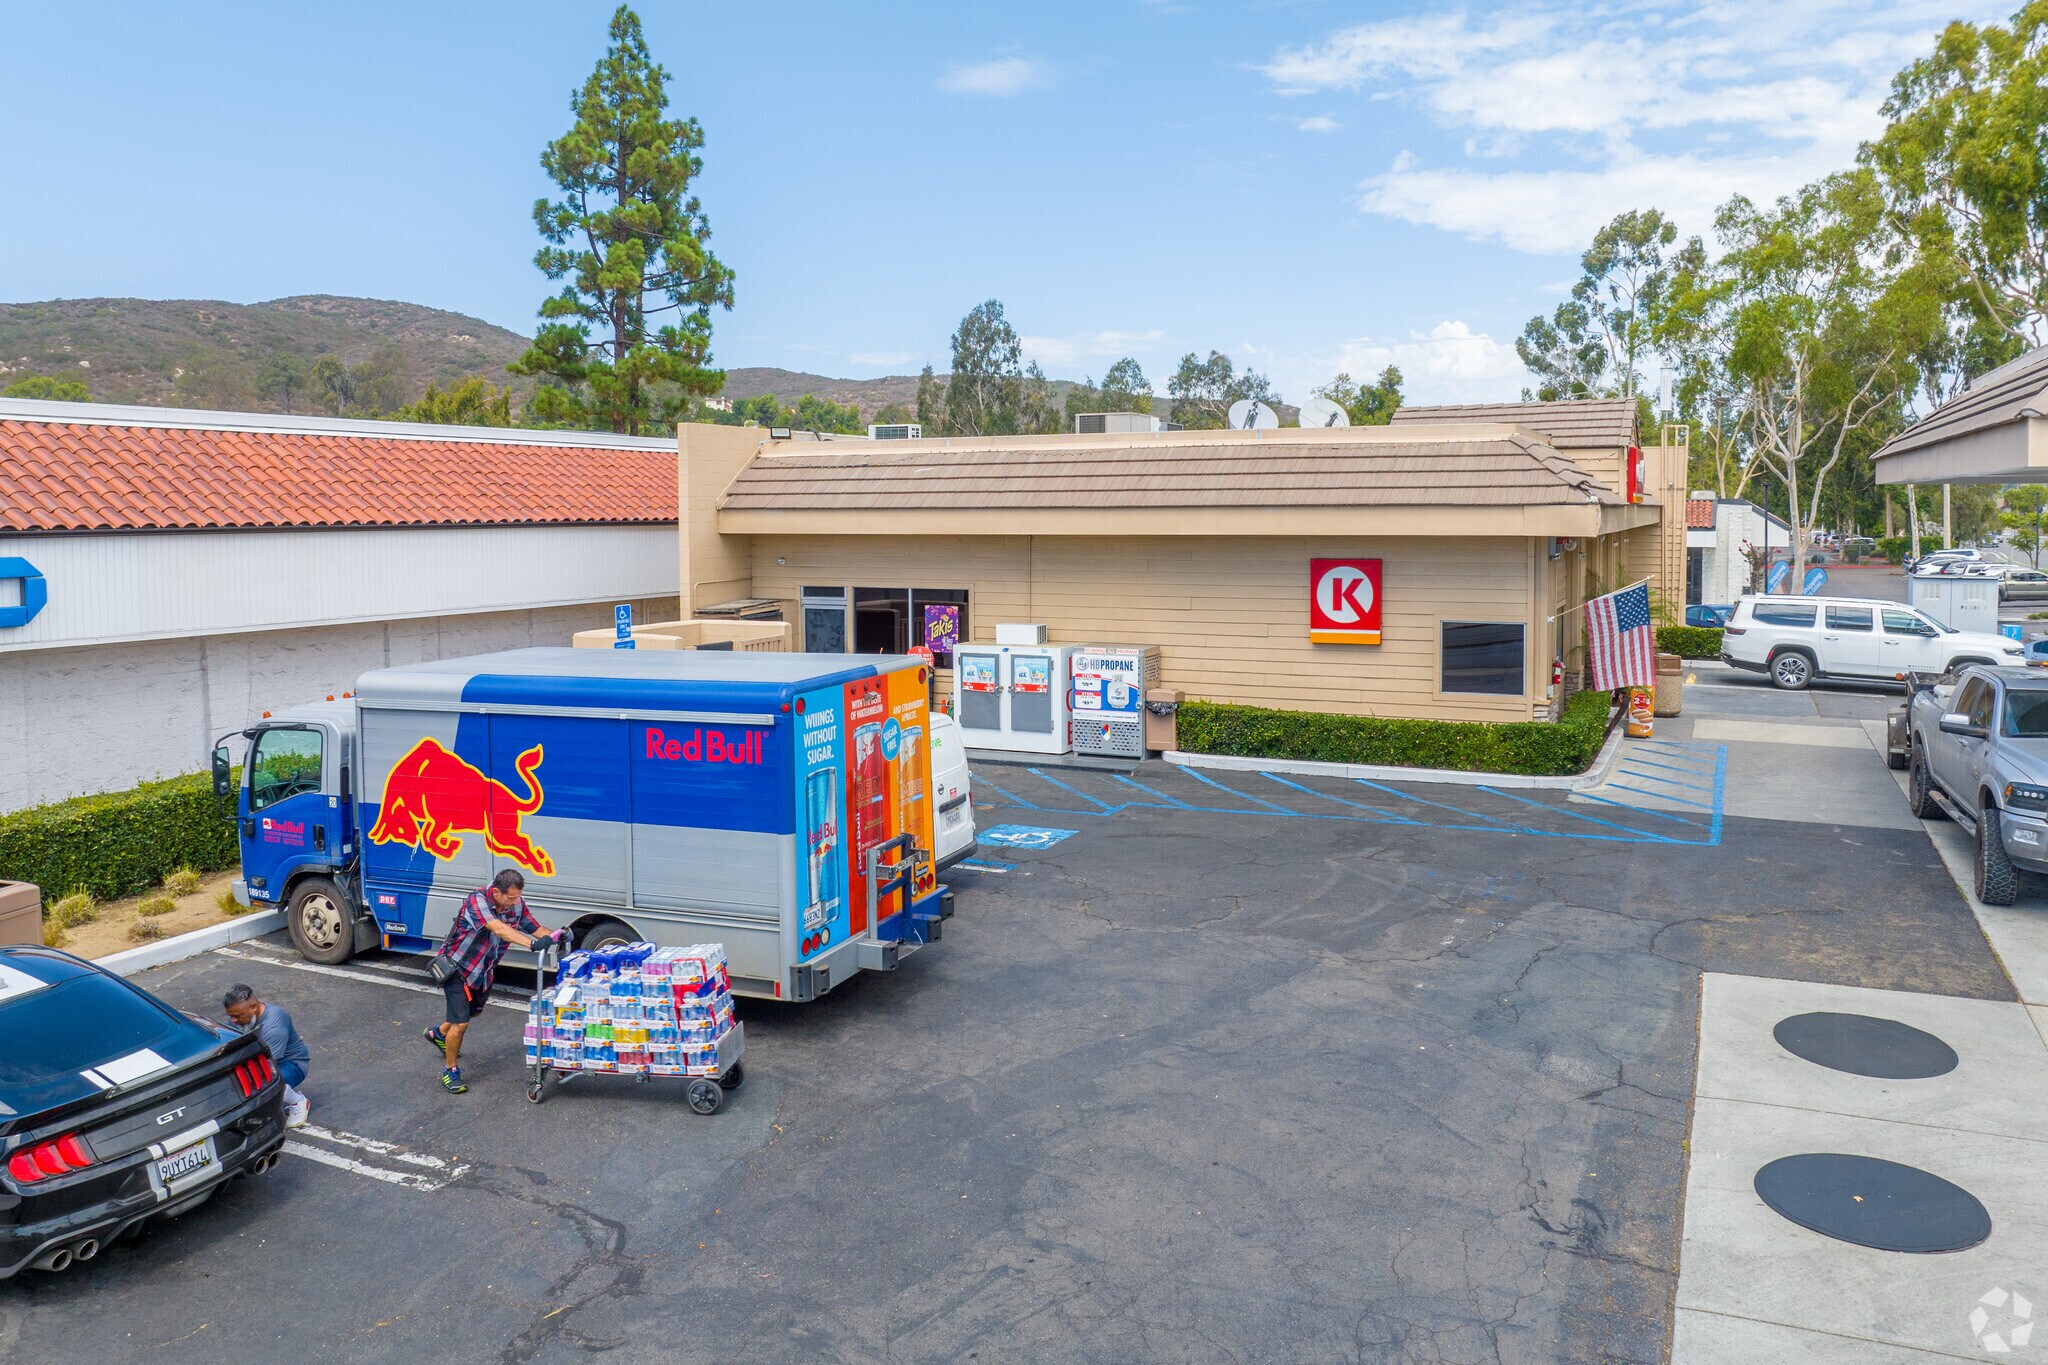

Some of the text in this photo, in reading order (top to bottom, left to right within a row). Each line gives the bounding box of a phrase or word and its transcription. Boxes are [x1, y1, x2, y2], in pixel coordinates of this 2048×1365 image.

[1332, 577, 1368, 620] K
[928, 619, 954, 642] Takis
[1090, 659, 1134, 672] HBPROPANE
[850, 711, 858, 721] OF
[646, 727, 702, 761] Red
[803, 725, 837, 748] WITHOUT
[883, 725, 898, 743] SUGAR
[886, 737, 897, 752] FREE
[807, 744, 835, 766] SUGAR.
[270, 818, 287, 832] Red
[287, 821, 305, 835] Bull
[248, 887, 270, 899] 189135
[156, 1105, 186, 1126] GT
[161, 1148, 207, 1181] 9UYT614
